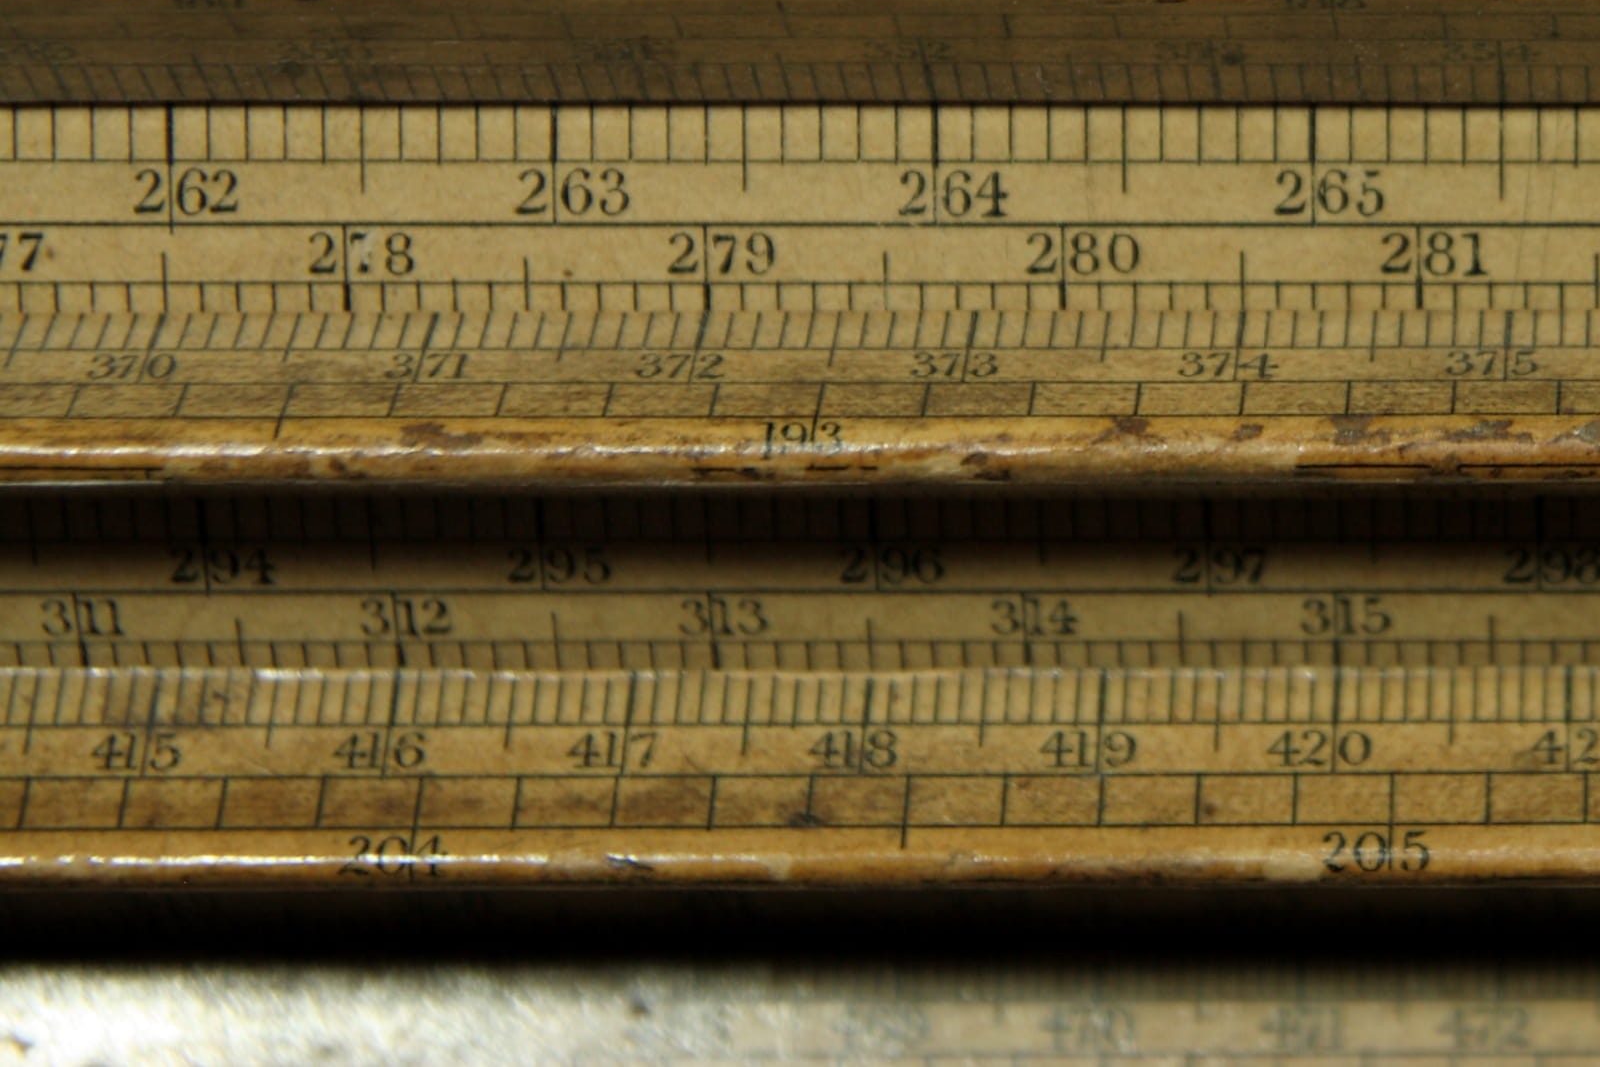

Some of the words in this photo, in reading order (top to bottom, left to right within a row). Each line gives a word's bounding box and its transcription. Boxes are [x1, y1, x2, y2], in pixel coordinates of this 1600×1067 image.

[133, 170, 239, 216] 262
[514, 170, 631, 215] 263
[900, 172, 1009, 217] 264
[1275, 172, 1386, 216] 265
[309, 233, 416, 276] 278
[669, 233, 776, 275] 279
[1026, 233, 1141, 276] 280
[1380, 233, 1489, 276] 281
[88, 353, 177, 380] 370
[384, 352, 470, 379] 371
[636, 352, 726, 379] 372
[909, 351, 999, 378] 373
[1178, 351, 1278, 378] 374
[1447, 350, 1540, 376] 375
[170, 548, 275, 585] 294
[508, 548, 612, 584] 295
[839, 548, 945, 584] 296
[1172, 548, 1270, 584] 297
[39, 599, 125, 637] 311
[361, 599, 453, 636] 312
[680, 599, 768, 636] 313
[991, 599, 1078, 635] 314
[1301, 599, 1392, 635] 315
[92, 732, 181, 772] 415
[333, 732, 427, 770] 416
[567, 732, 660, 770] 417
[805, 730, 899, 769] 418
[1041, 730, 1137, 766] 419
[1268, 729, 1373, 766] 420
[338, 835, 447, 876] 204
[1322, 832, 1431, 872] 205
